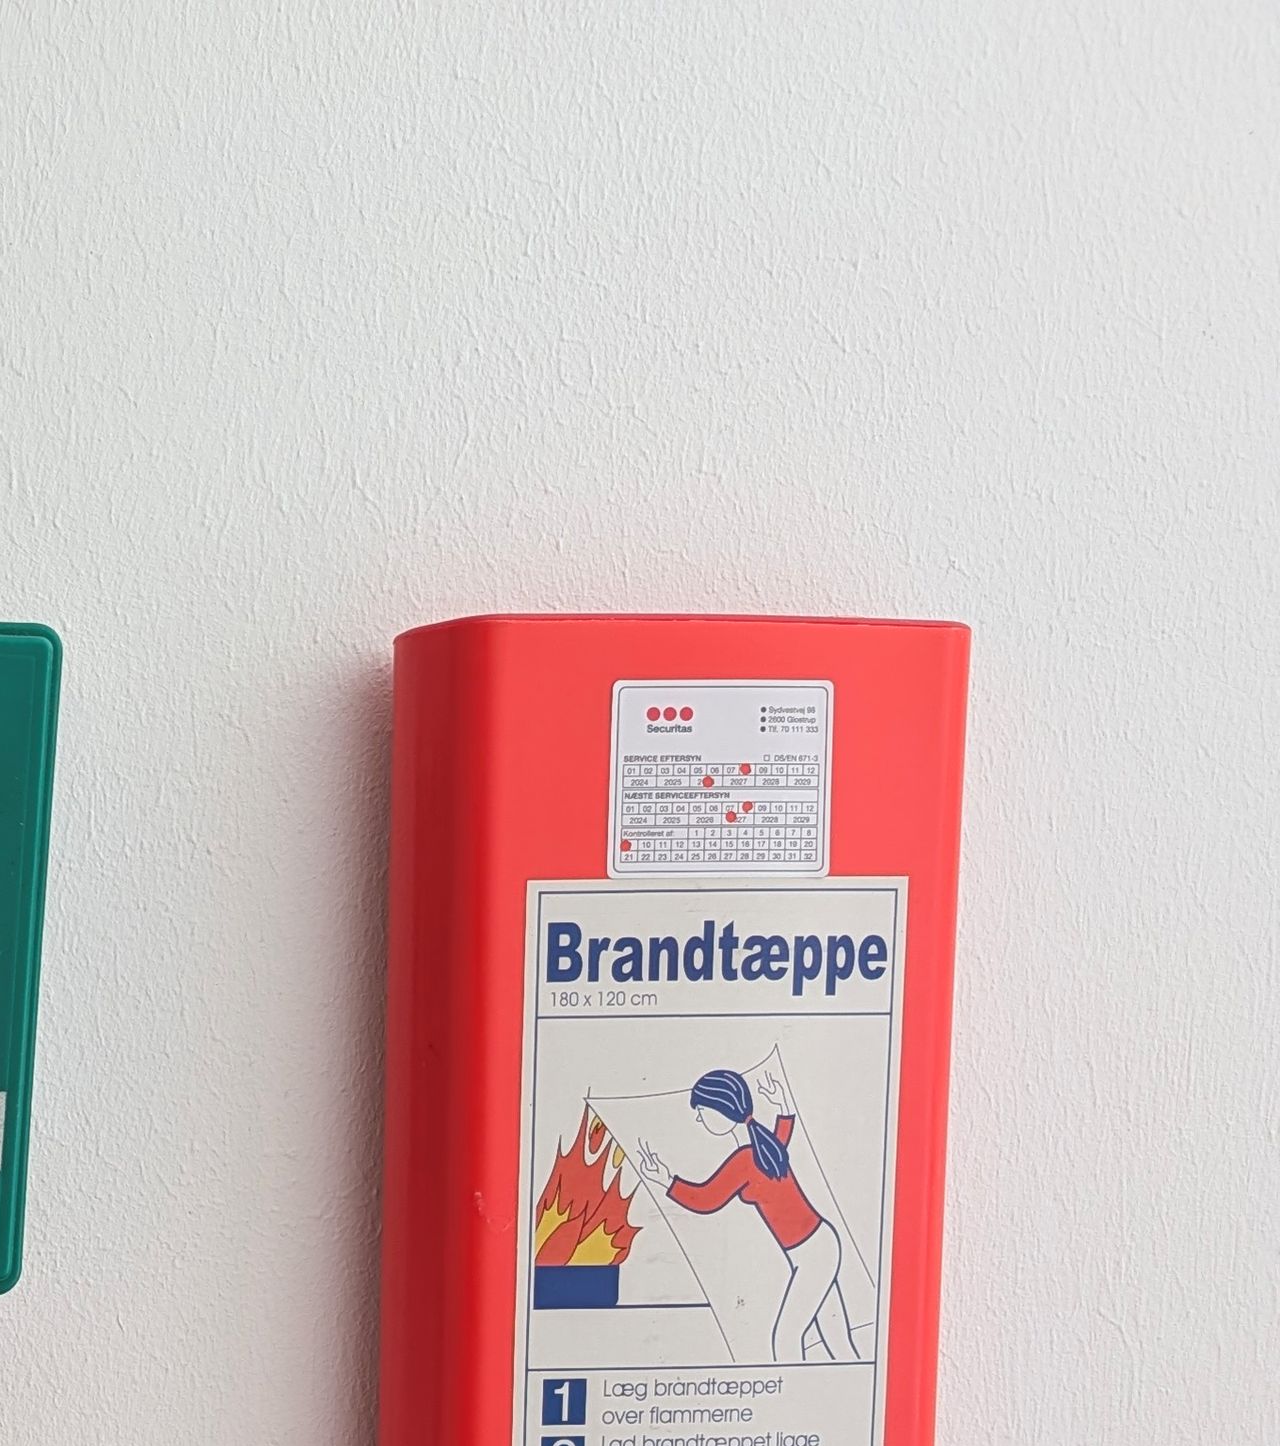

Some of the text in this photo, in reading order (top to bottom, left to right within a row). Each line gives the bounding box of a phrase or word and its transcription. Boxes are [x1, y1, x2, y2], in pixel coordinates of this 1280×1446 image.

[646, 724, 693, 733] Securitas
[791, 725, 803, 733] 111
[623, 755, 658, 763] SERVICE
[630, 778, 649, 786] 2024
[664, 778, 682, 786] 2025
[730, 778, 747, 786] 2027
[762, 778, 780, 786] 2028
[794, 778, 811, 786] 2029
[624, 791, 730, 800] NÆSTE SERVICEEFTERSYN
[545, 920, 888, 996] Brandtæppe
[550, 990, 658, 1007] 180 x 120 cm
[603, 1375, 784, 1401] Læg brandtæppet
[553, 1381, 570, 1422] 1
[602, 1405, 754, 1424] over flammerne
